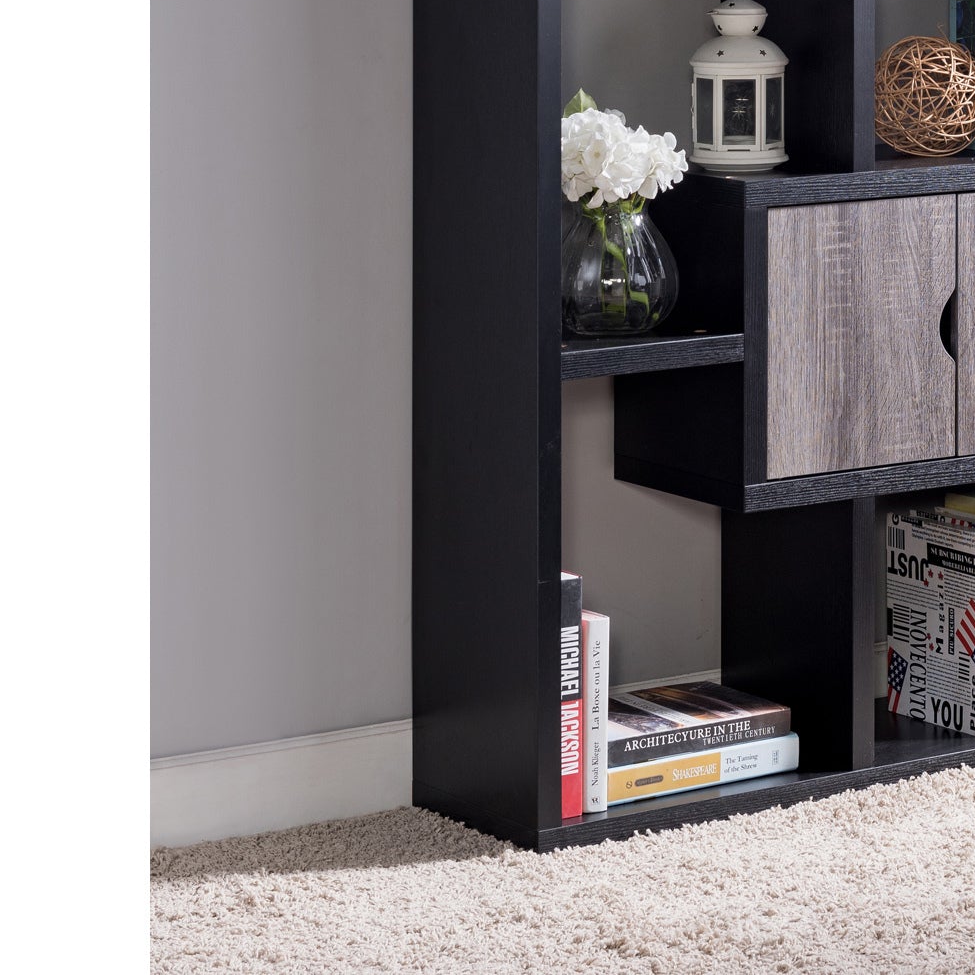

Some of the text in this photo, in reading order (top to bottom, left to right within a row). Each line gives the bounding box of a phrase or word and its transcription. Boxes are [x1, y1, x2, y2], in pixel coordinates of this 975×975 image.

[888, 551, 929, 582] JUST
[592, 640, 600, 658] Vie
[561, 625, 579, 700] MICHAEL
[592, 660, 600, 669] la
[594, 672, 600, 685] ou
[592, 688, 600, 714] Boxe
[930, 697, 964, 731] YOU
[592, 716, 600, 731] La
[713, 724, 726, 736] IN
[729, 720, 751, 734] THE
[744, 726, 776, 739] CENTURY
[561, 700, 579, 776] JACKSON
[592, 741, 600, 766] Klieger
[725, 753, 759, 765] The Taming
[672, 762, 718, 782] SHAKESPEARE
[724, 765, 731, 774] of
[731, 764, 740, 773] the
